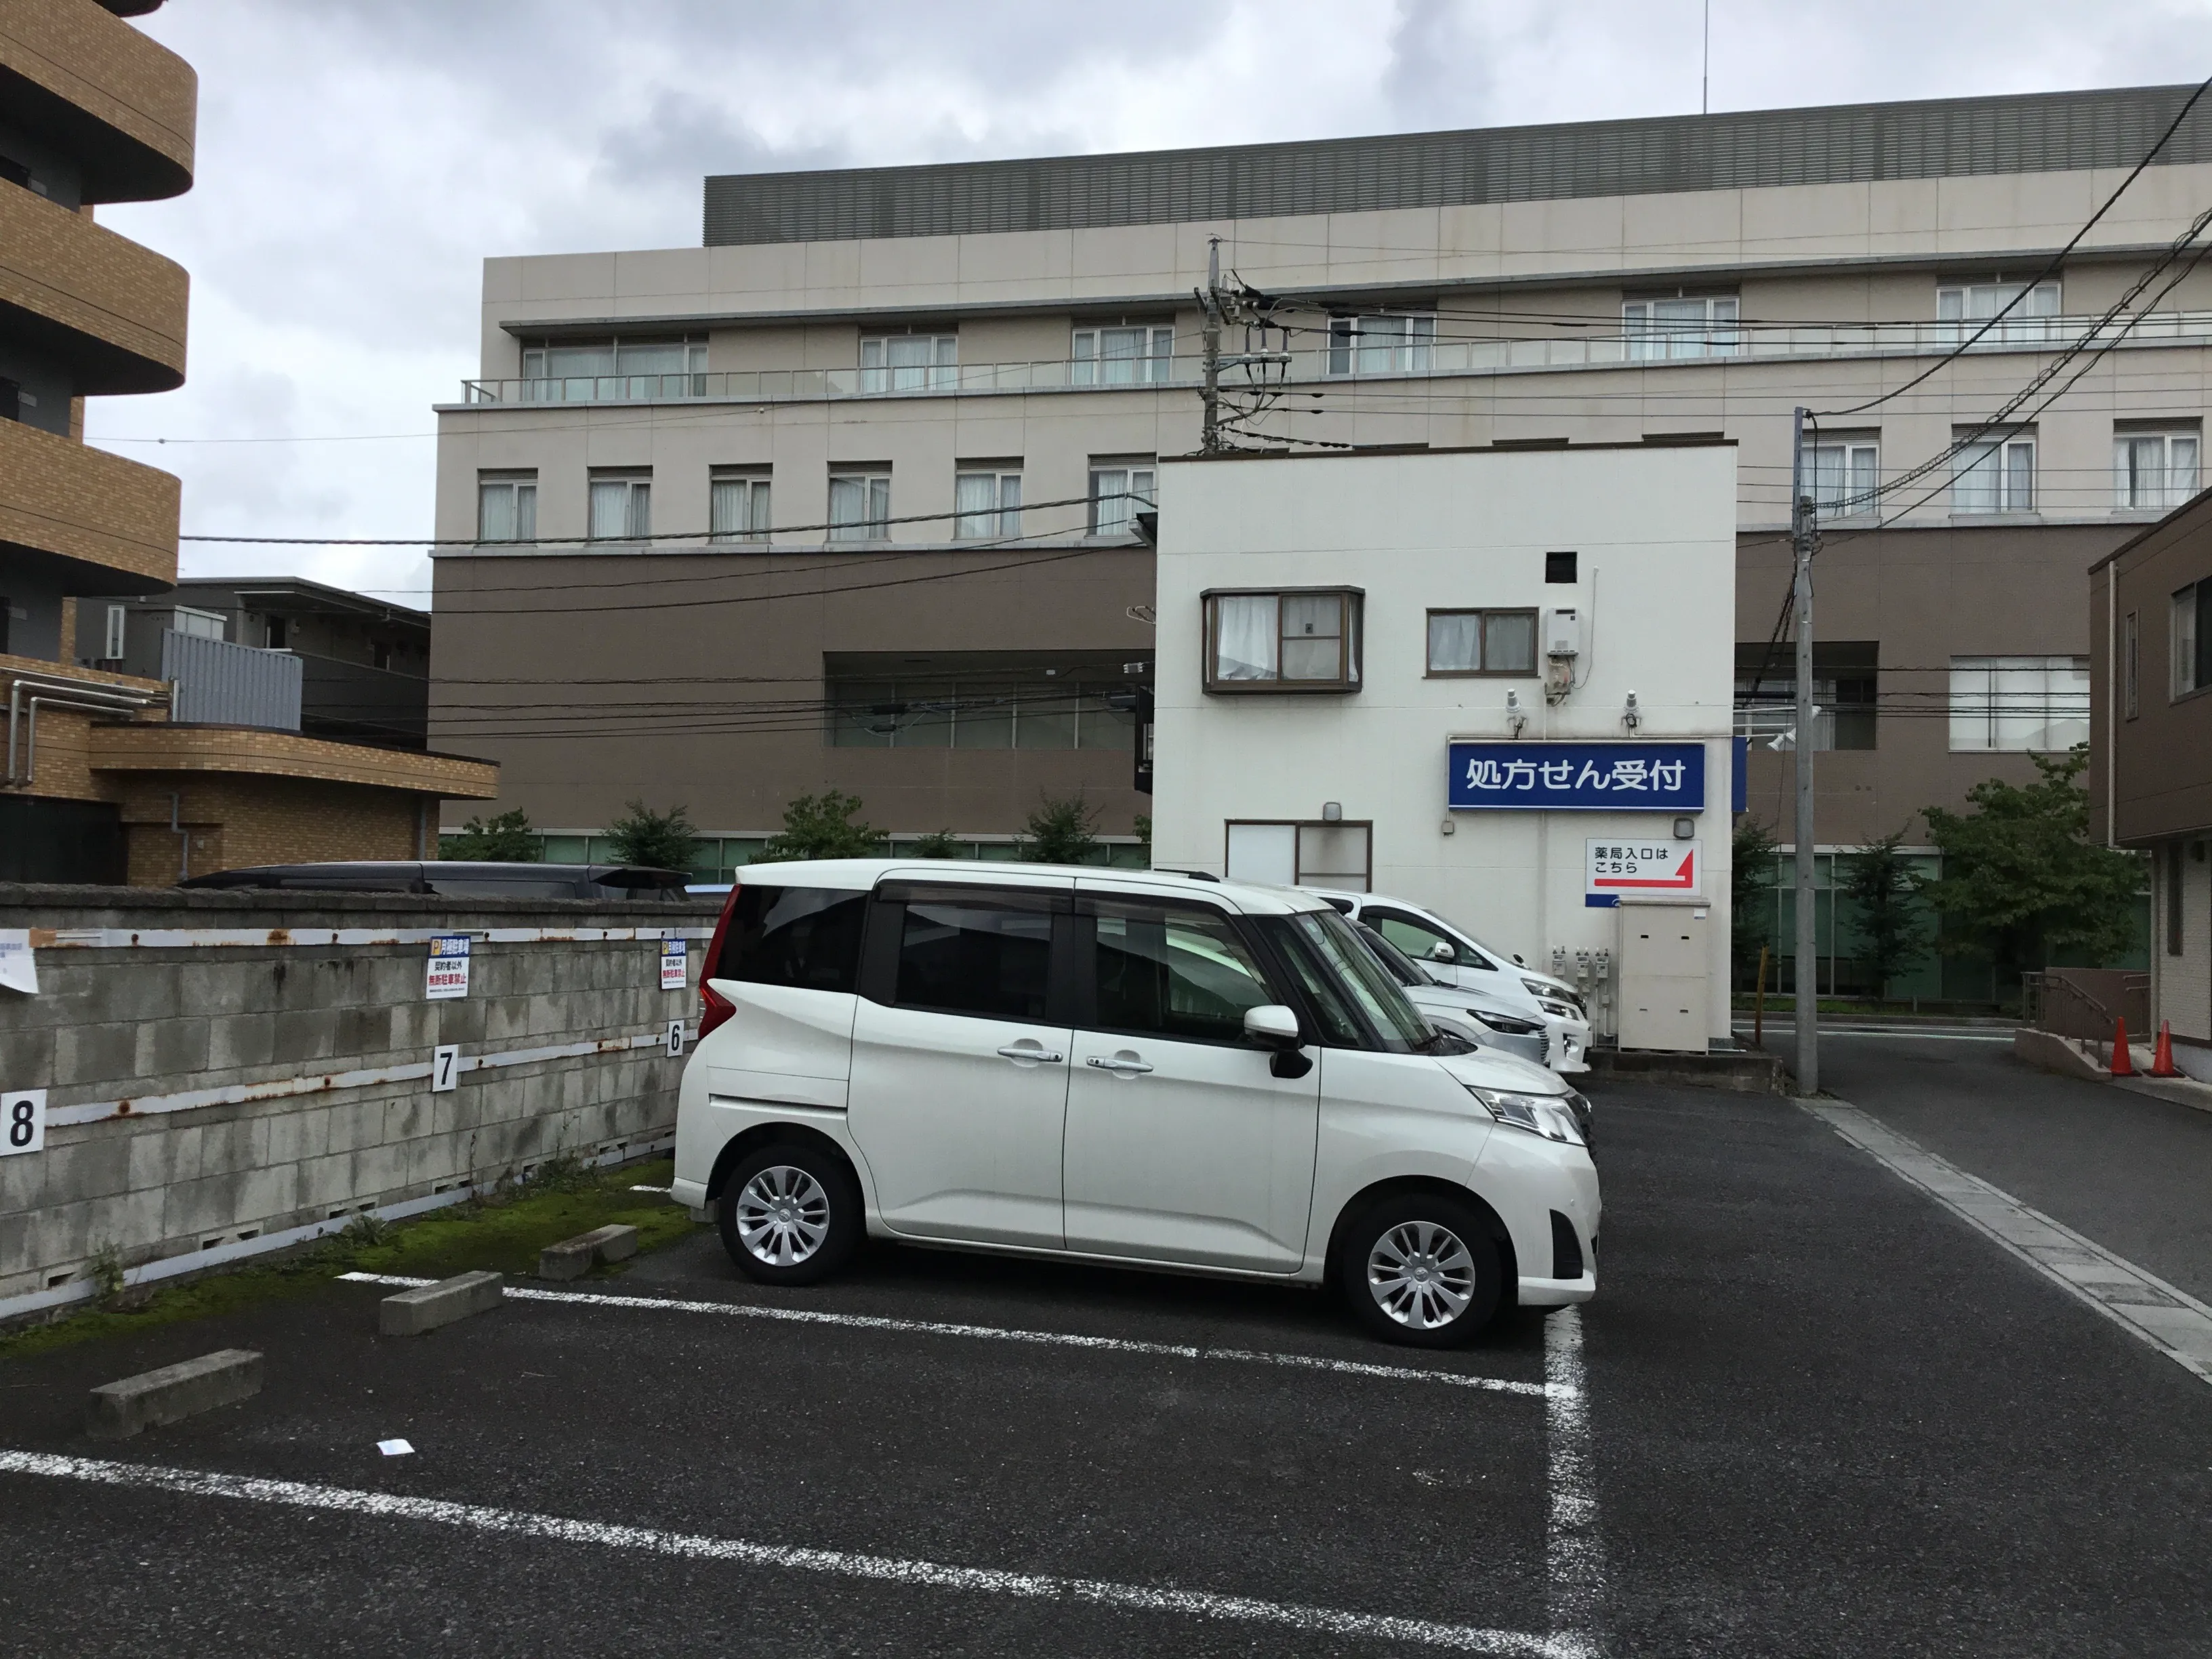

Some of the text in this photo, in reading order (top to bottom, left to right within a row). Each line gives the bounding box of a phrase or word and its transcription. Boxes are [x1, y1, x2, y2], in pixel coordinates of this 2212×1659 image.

[1466, 758, 1686, 792] 処方せん受付
[1595, 846, 1668, 860] 薬局入口は
[1595, 862, 1637, 874] こちら
[672, 1025, 680, 1051] 6
[440, 1052, 453, 1086] 7
[10, 1101, 33, 1147] 8
